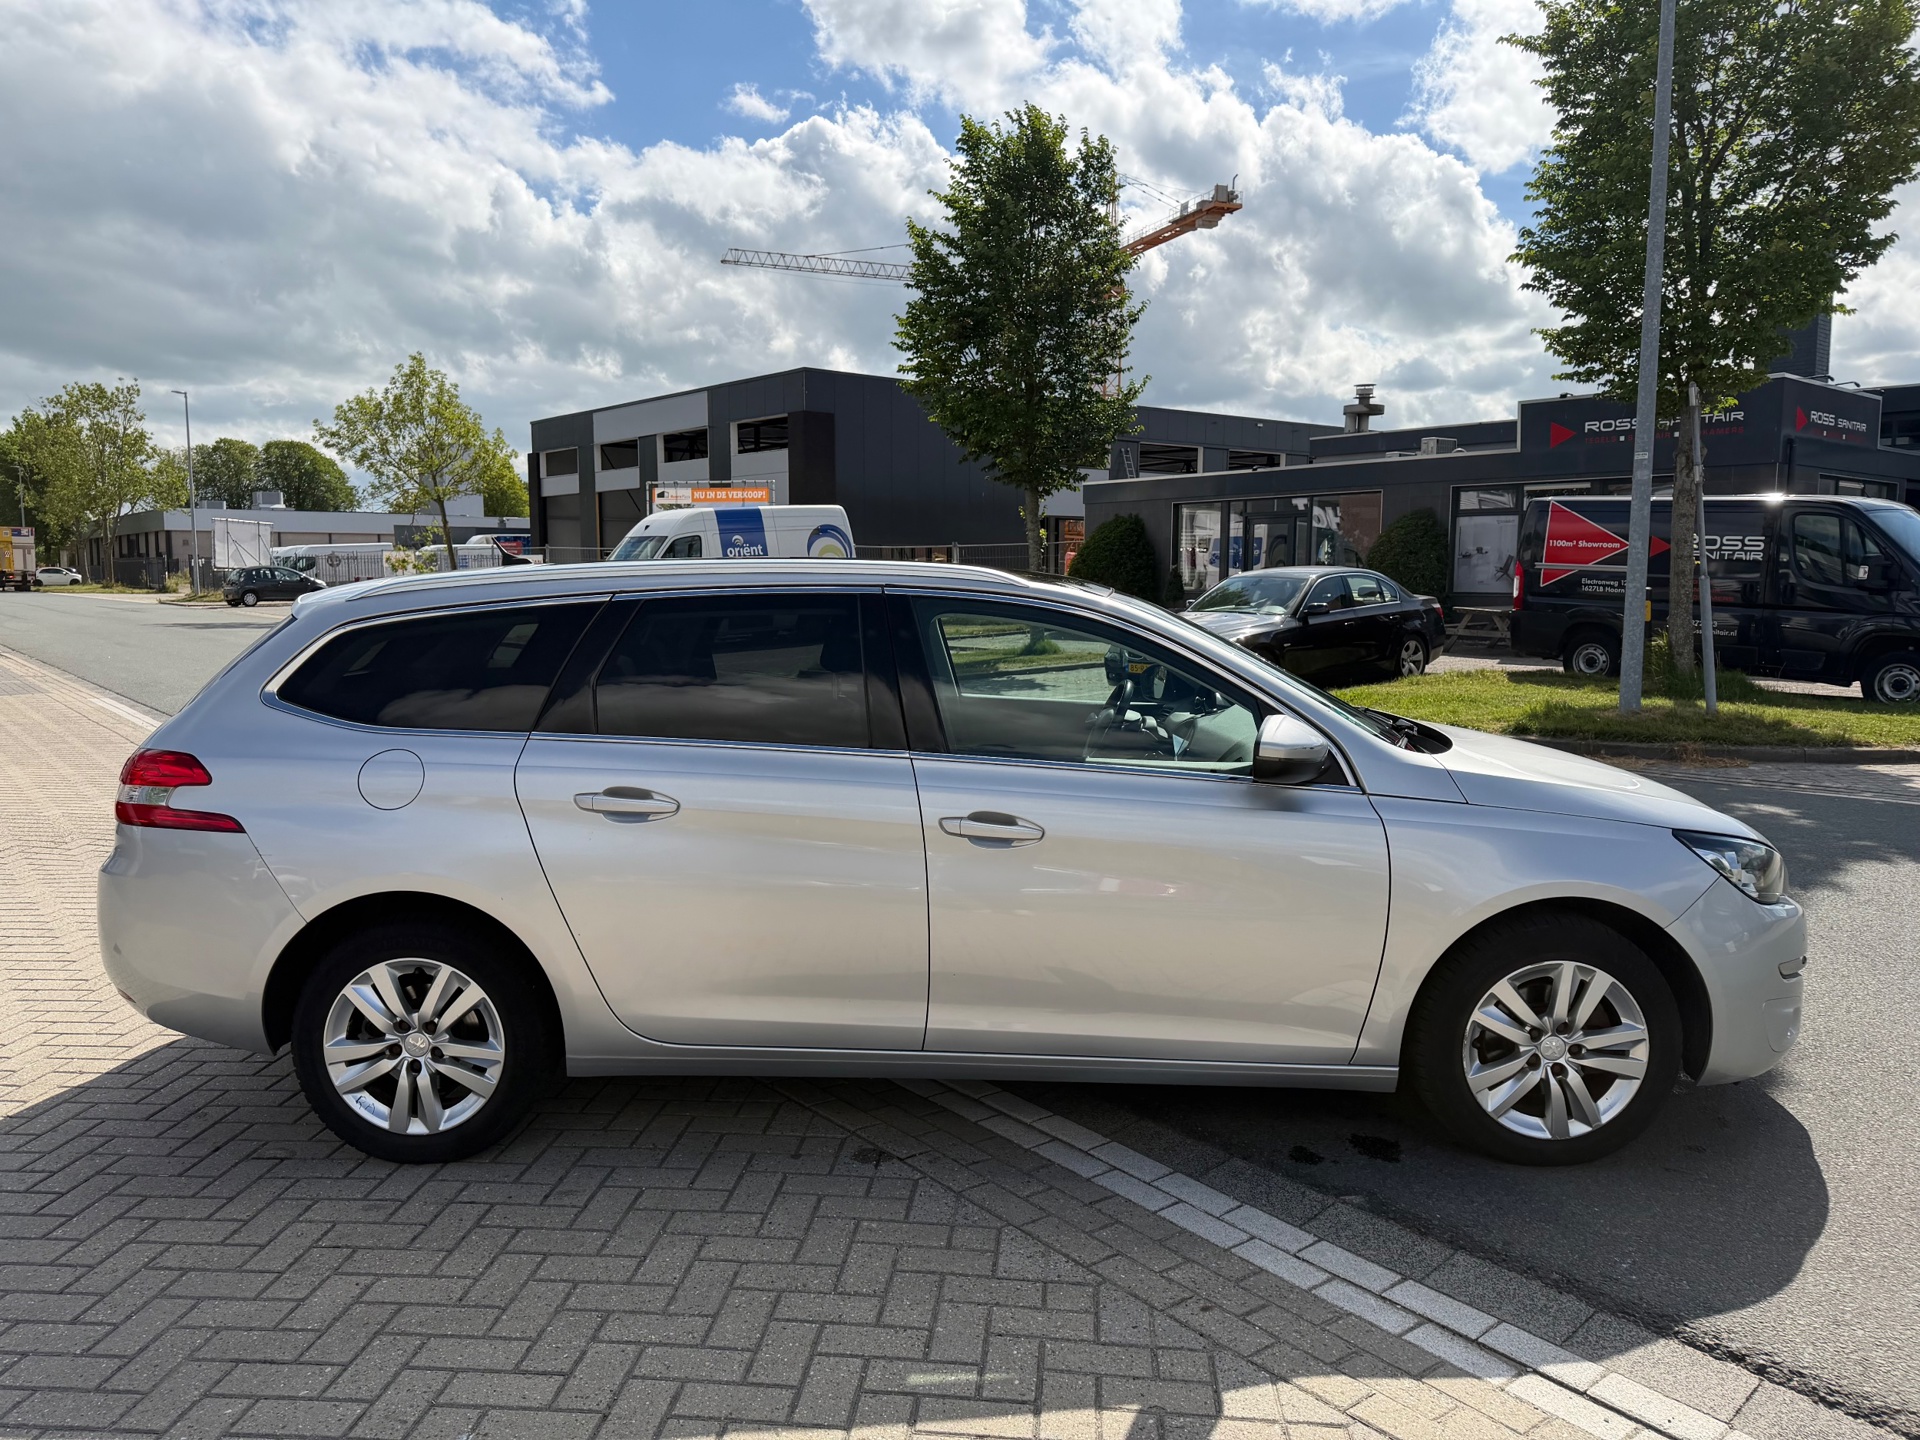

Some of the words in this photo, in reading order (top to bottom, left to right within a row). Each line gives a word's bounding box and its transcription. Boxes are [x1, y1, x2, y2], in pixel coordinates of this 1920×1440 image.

[1810, 411, 1835, 426] ROSS
[1837, 418, 1867, 432] SANITAIR
[693, 491, 706, 499] NU
[706, 491, 716, 499] IN
[717, 491, 727, 499] DE
[728, 491, 766, 499] VERKOOP!
[1578, 540, 1620, 549] Showroom
[727, 543, 764, 557] oriënt
[1581, 578, 1618, 586] Electronweg
[1605, 585, 1625, 593] Hoorn
